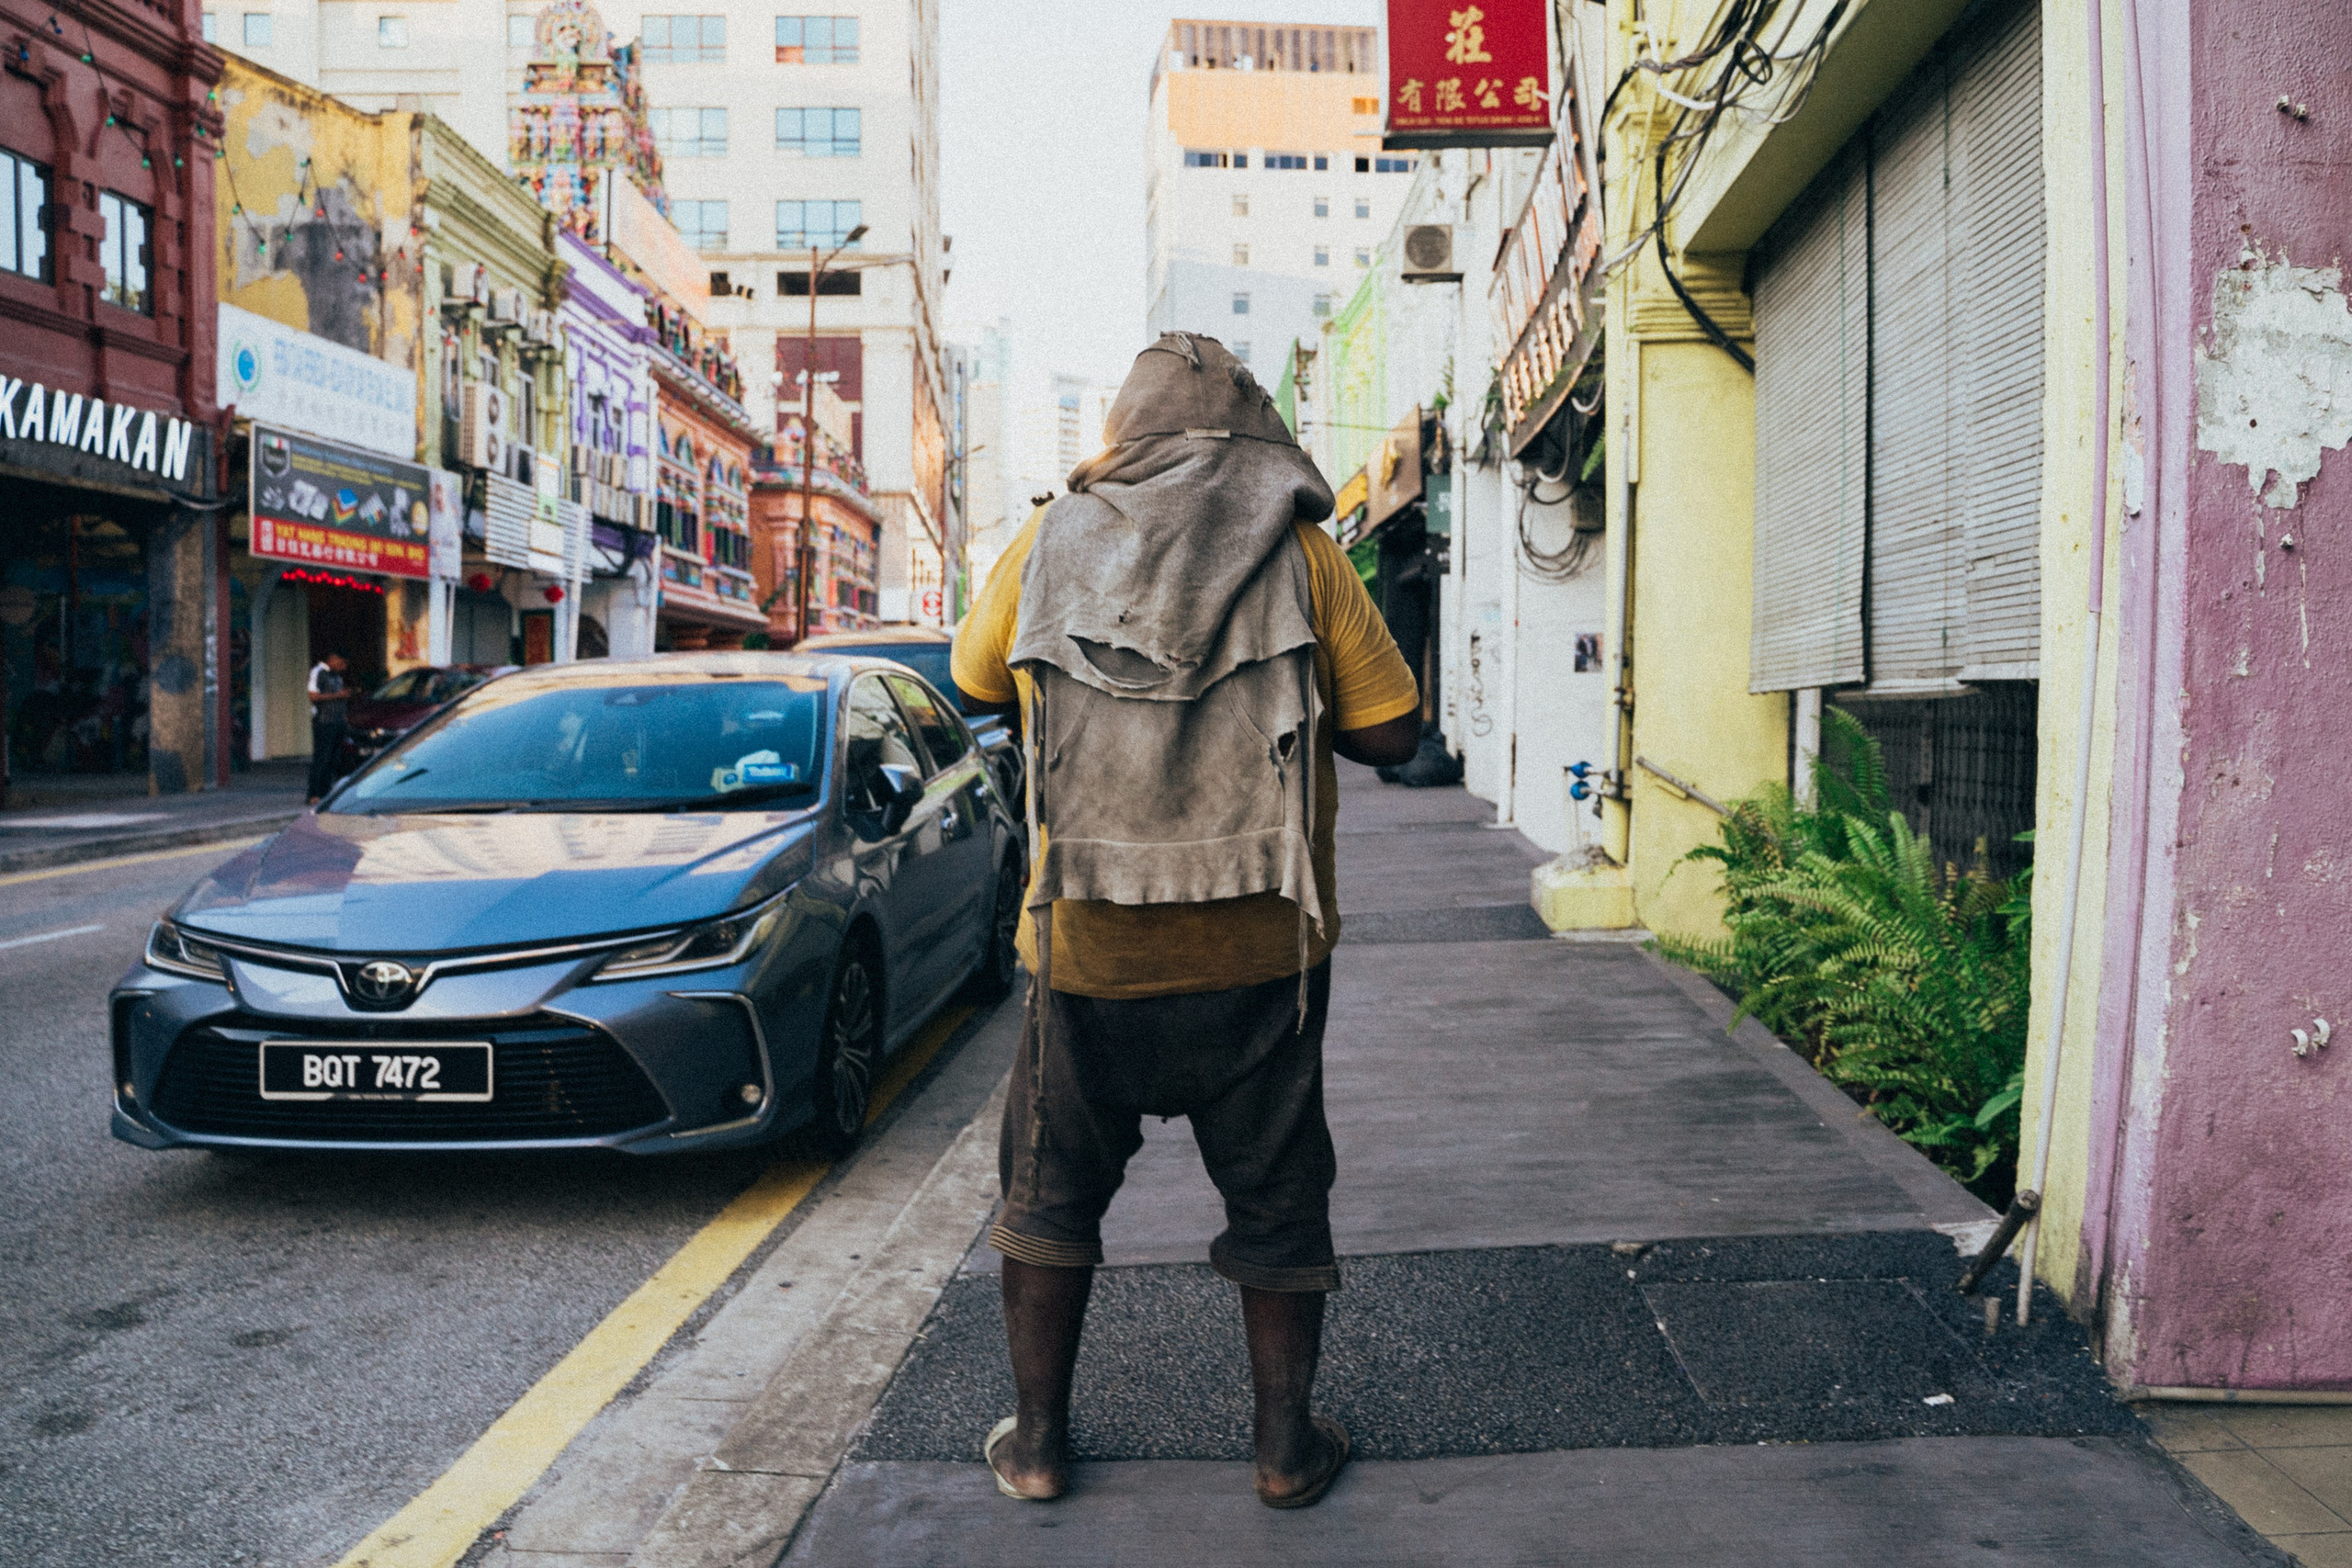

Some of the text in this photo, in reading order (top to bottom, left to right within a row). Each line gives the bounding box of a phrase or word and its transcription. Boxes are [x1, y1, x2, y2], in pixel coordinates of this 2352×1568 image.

[1396, 76, 1543, 114] 有限公司
[0, 374, 192, 481] KAMAKAN
[302, 1054, 441, 1089] BQT 7472
